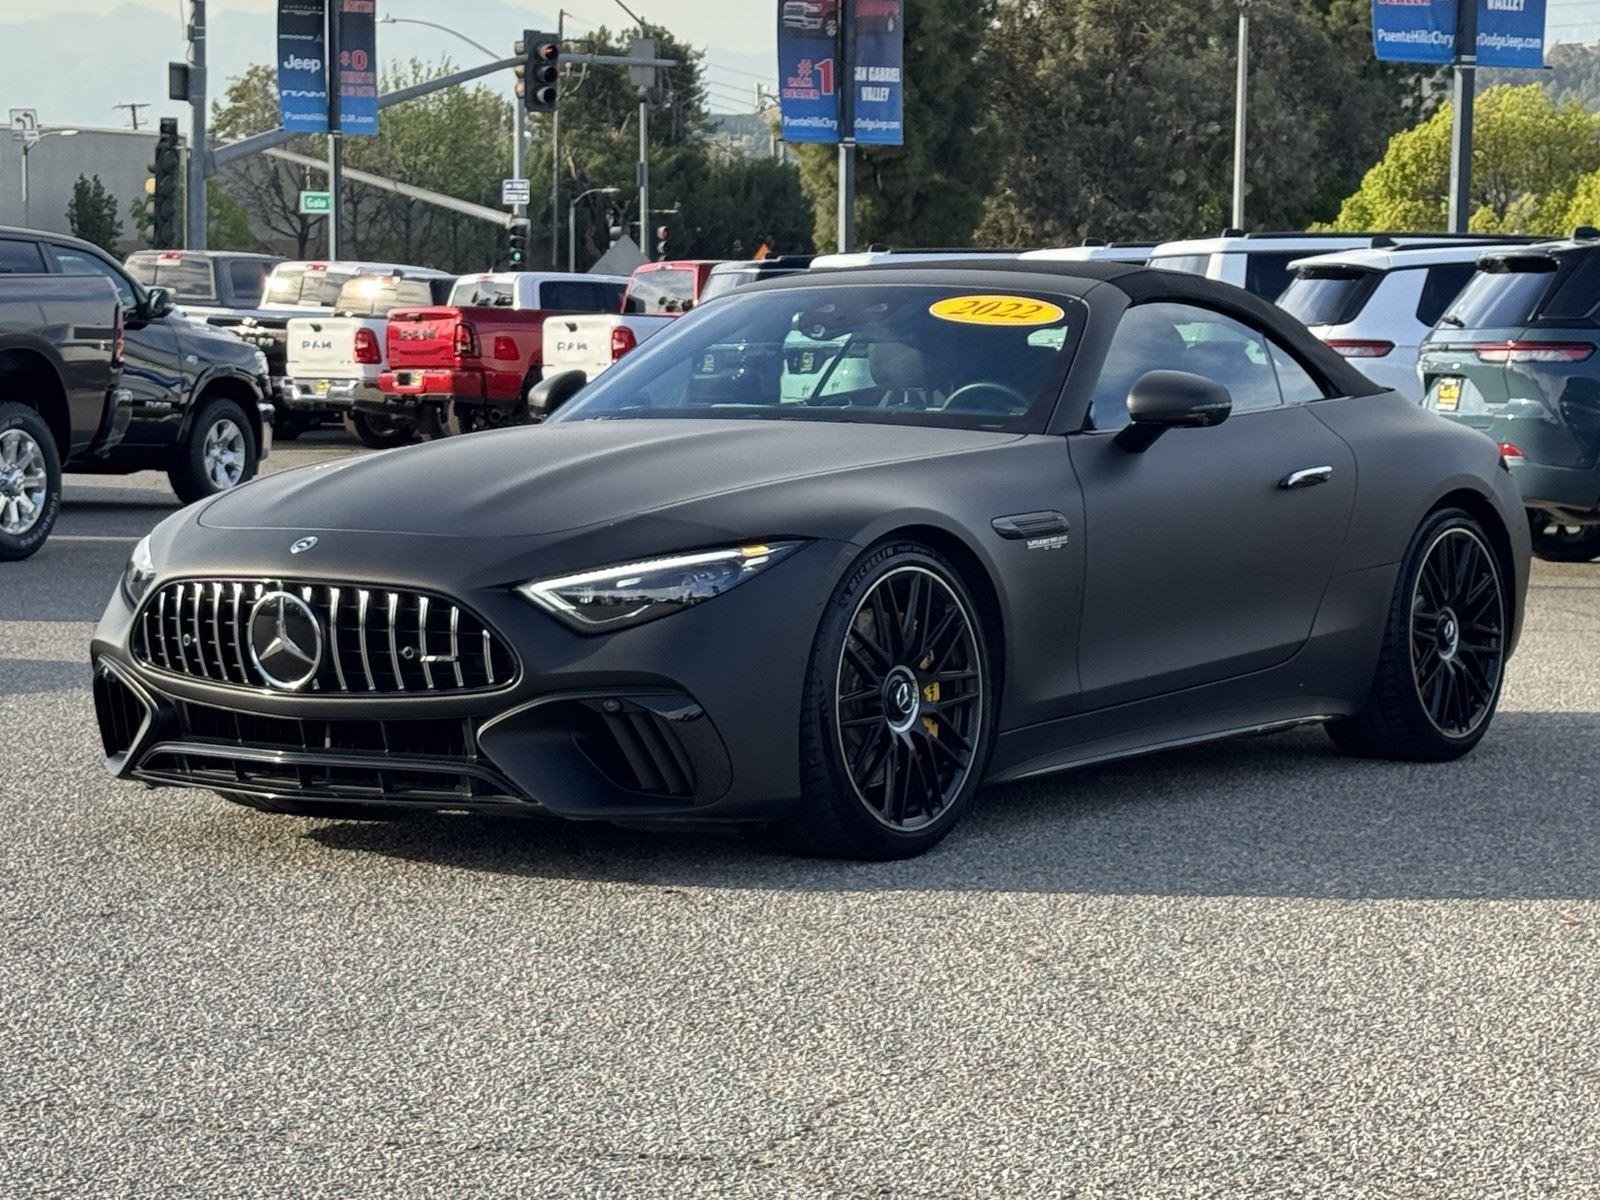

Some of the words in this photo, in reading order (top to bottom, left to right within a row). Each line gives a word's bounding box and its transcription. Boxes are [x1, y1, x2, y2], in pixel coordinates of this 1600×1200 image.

[284, 54, 321, 73] Jeep
[797, 58, 834, 95] #1
[948, 300, 1043, 319] 2022
